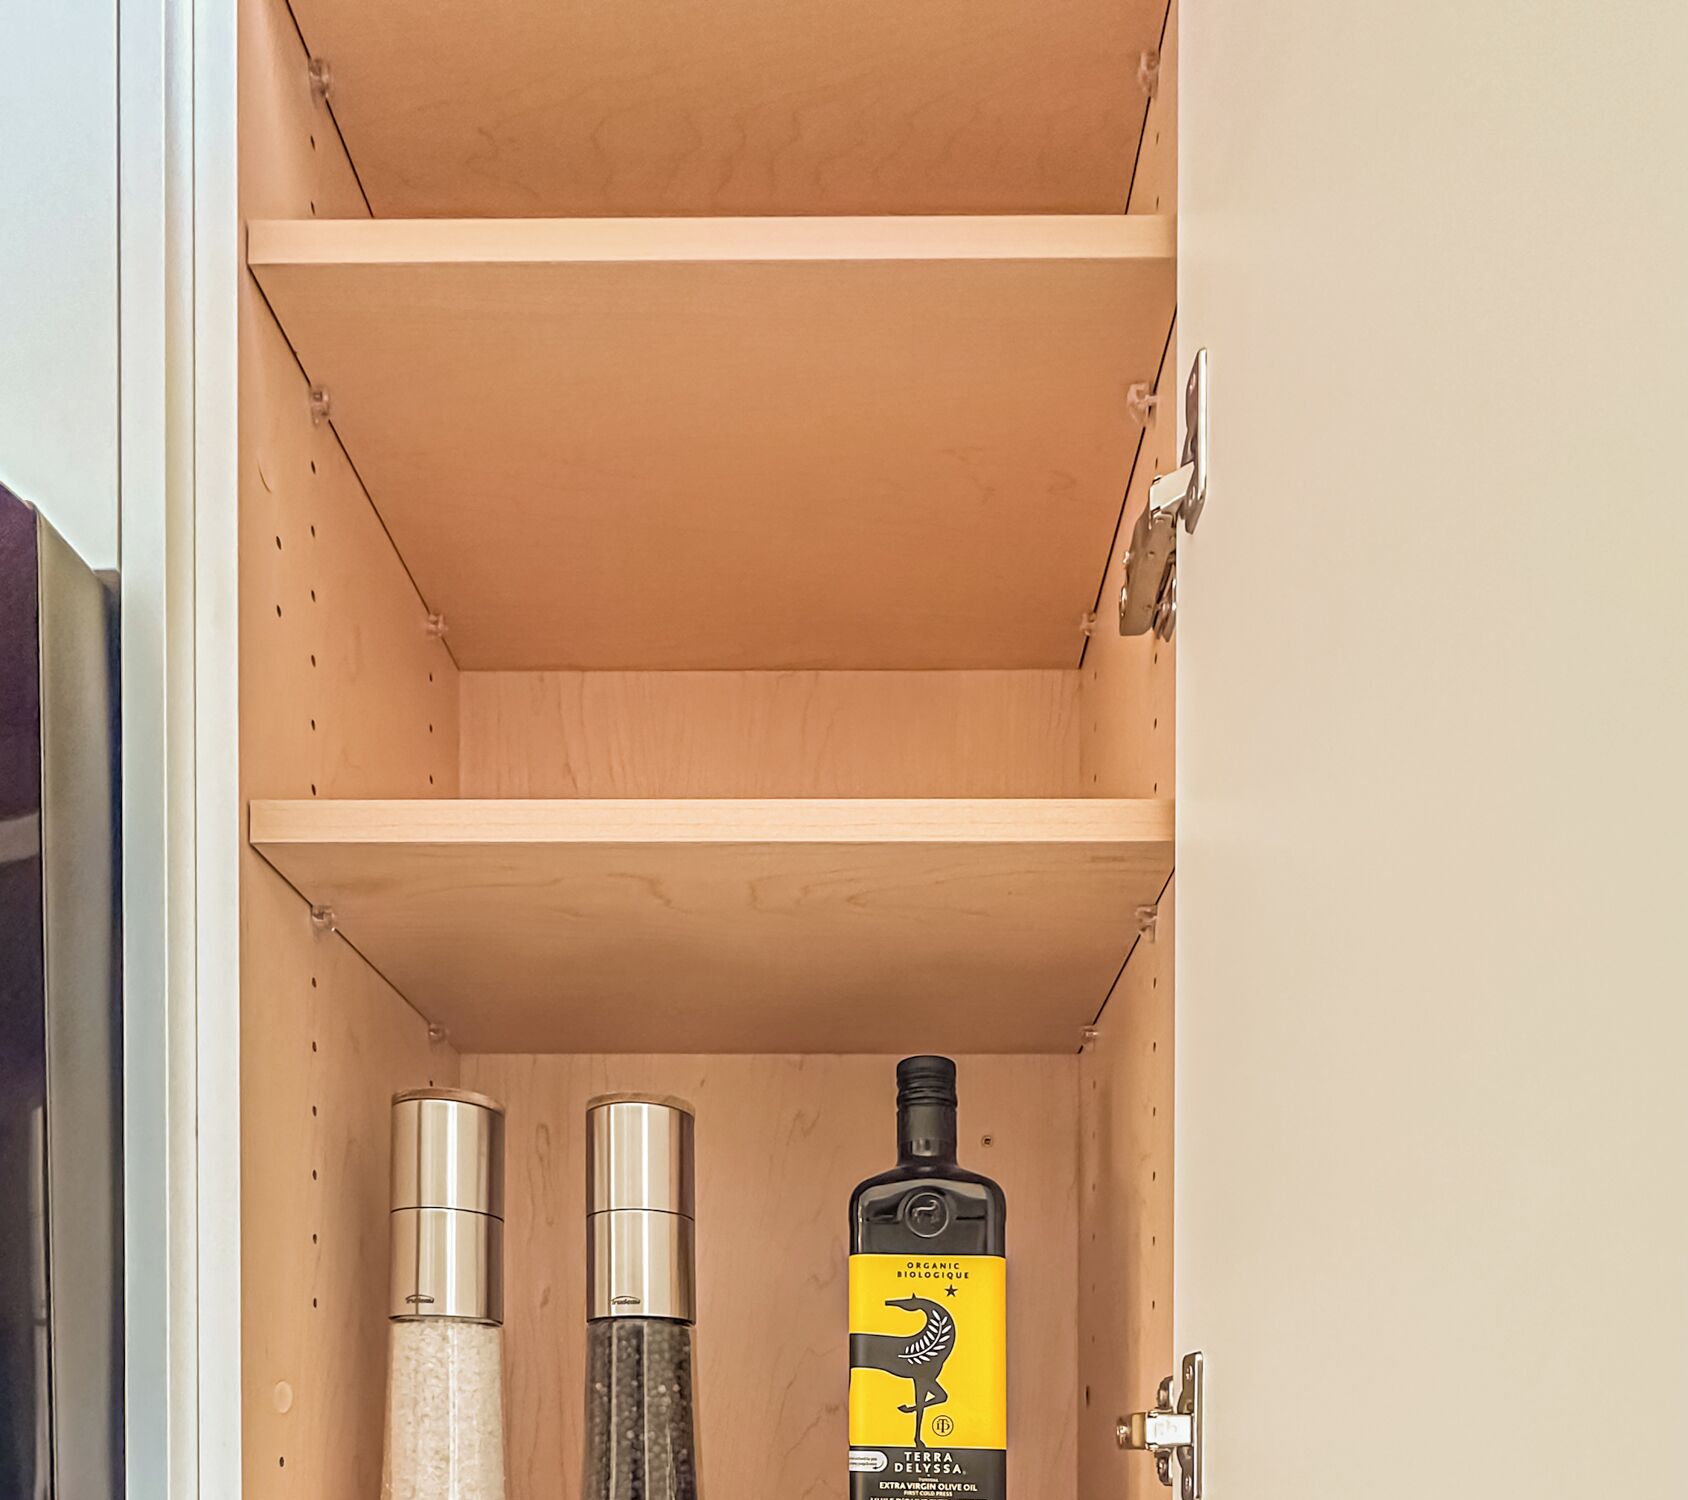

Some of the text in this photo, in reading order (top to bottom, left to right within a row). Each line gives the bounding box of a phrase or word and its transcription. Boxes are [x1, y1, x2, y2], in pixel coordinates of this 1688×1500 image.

[906, 1262, 960, 1270] ORGANIC
[896, 1271, 969, 1280] BIOLOGIQUE
[904, 1451, 953, 1463] TERRA
[894, 1462, 962, 1474] DELYSSA
[879, 1481, 978, 1492] EXTRA VIRGIN OLIVE OIL
